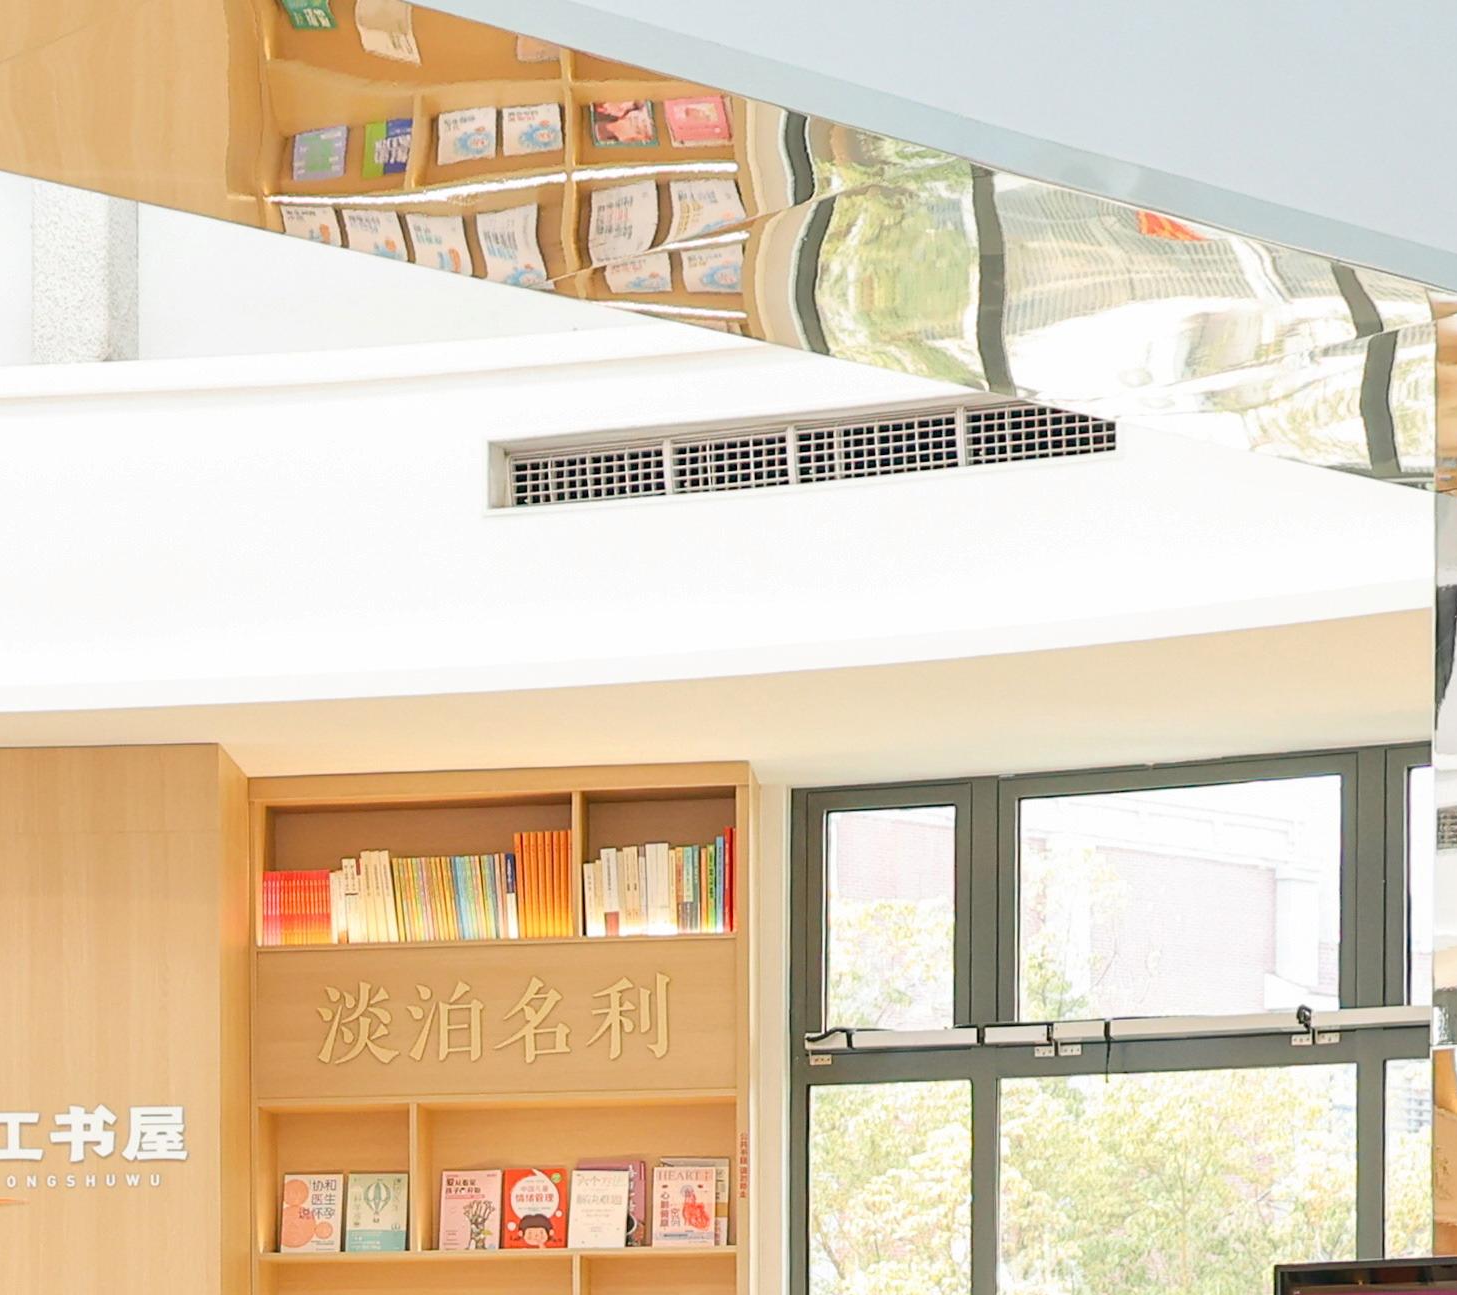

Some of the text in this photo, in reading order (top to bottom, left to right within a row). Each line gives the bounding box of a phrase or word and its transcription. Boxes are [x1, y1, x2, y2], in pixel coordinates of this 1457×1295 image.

[317, 972, 673, 1065] 淡泊名利
[312, 1180, 336, 1191] 协和
[311, 1194, 336, 1206] 医生
[298, 1206, 336, 1219] 说怀孕
